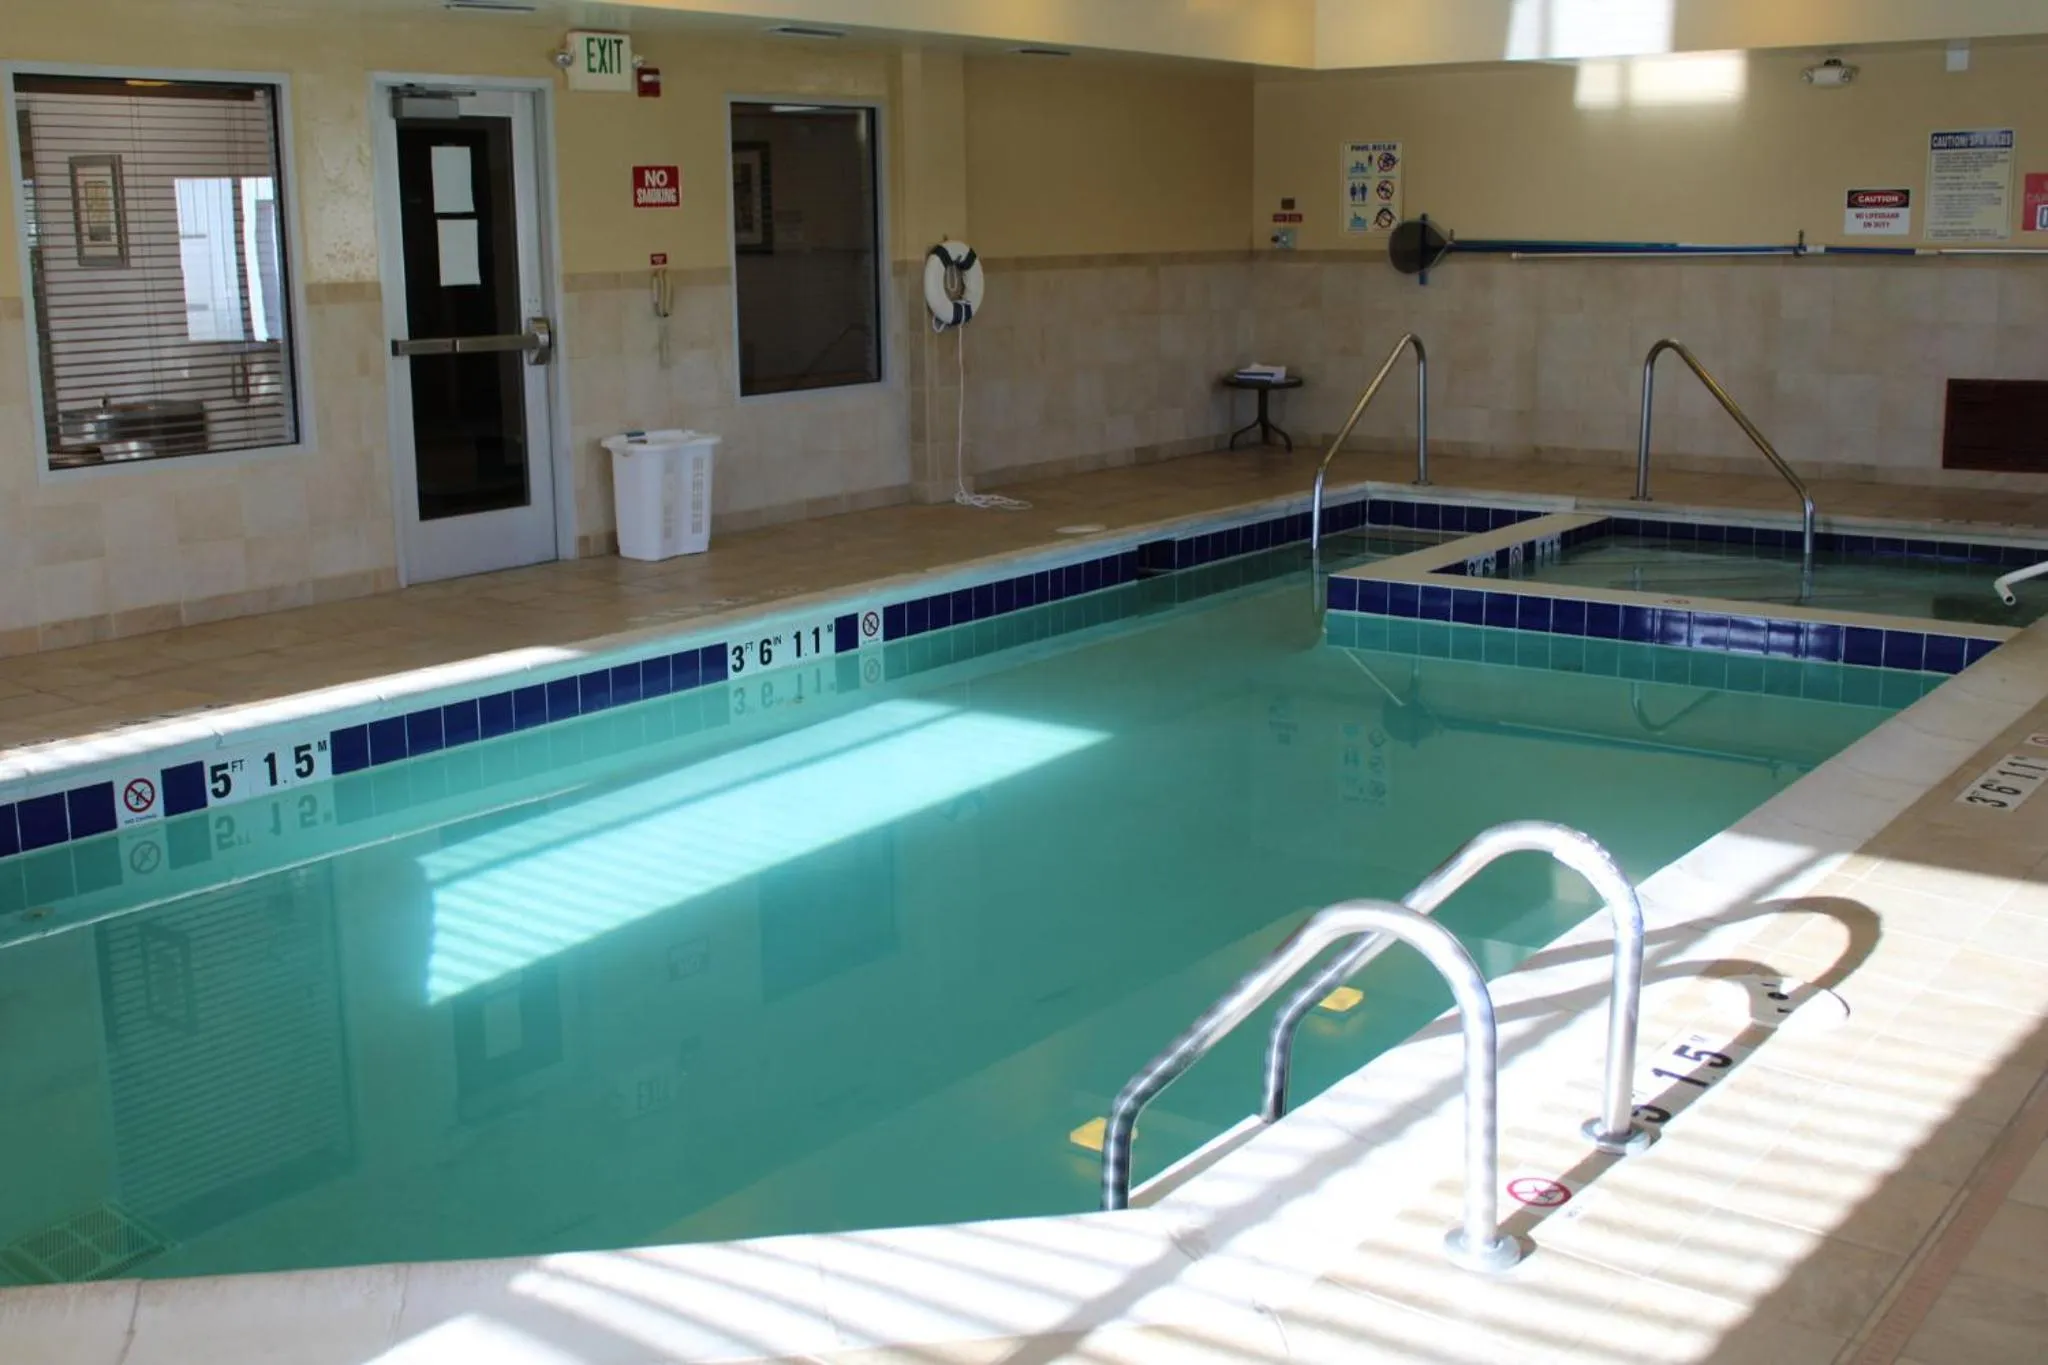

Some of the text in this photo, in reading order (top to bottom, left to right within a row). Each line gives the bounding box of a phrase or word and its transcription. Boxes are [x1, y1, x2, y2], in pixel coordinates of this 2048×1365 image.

[586, 38, 624, 74] EXIT
[644, 169, 668, 187] NO
[636, 187, 677, 204] SMOKING
[1857, 195, 1899, 203] CAUTION
